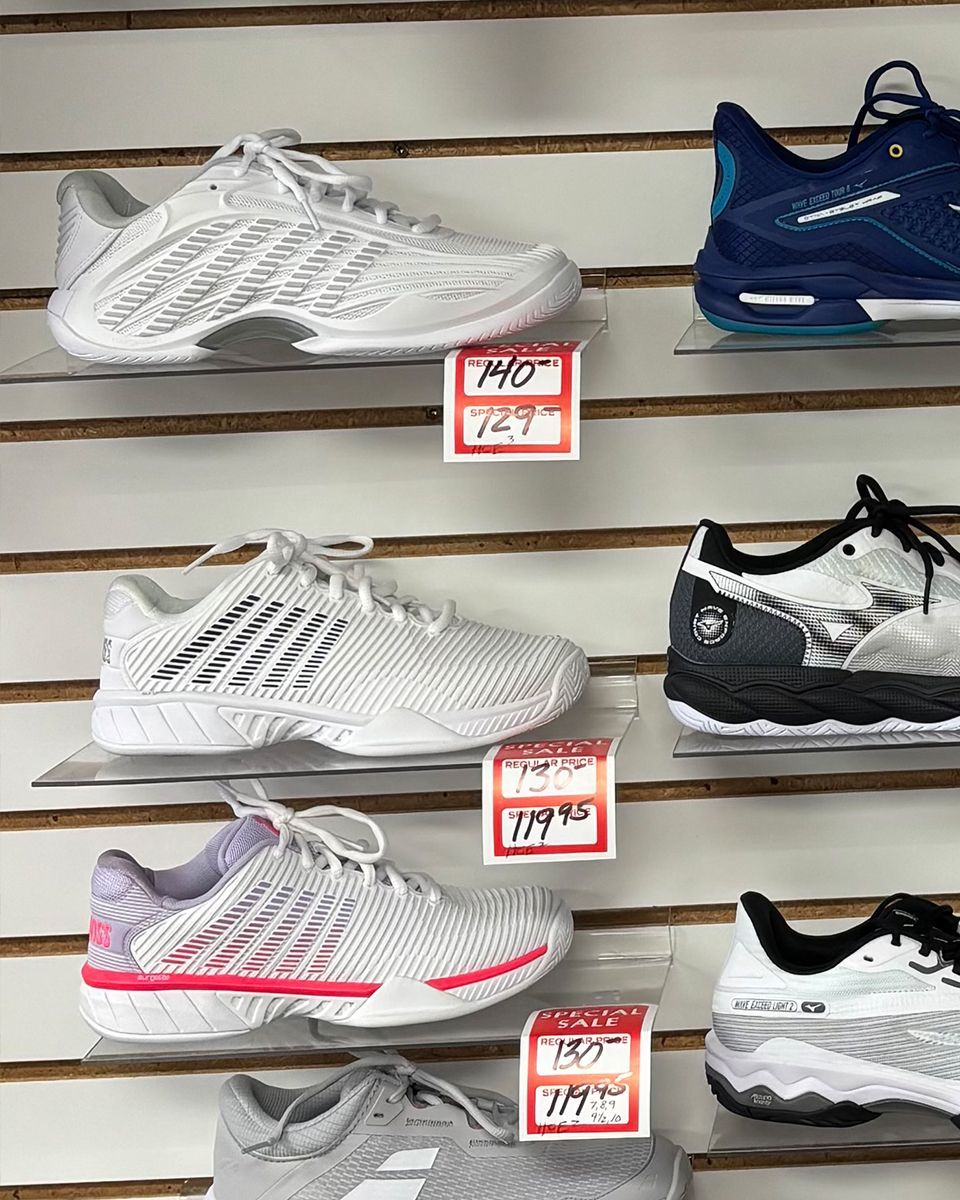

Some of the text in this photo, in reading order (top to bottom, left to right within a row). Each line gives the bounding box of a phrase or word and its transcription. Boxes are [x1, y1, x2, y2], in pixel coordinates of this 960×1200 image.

[523, 747, 584, 755] SALE
[561, 758, 595, 767] PRICE
[541, 1008, 642, 1019] SPECIAL
[557, 1017, 619, 1029] SALE
